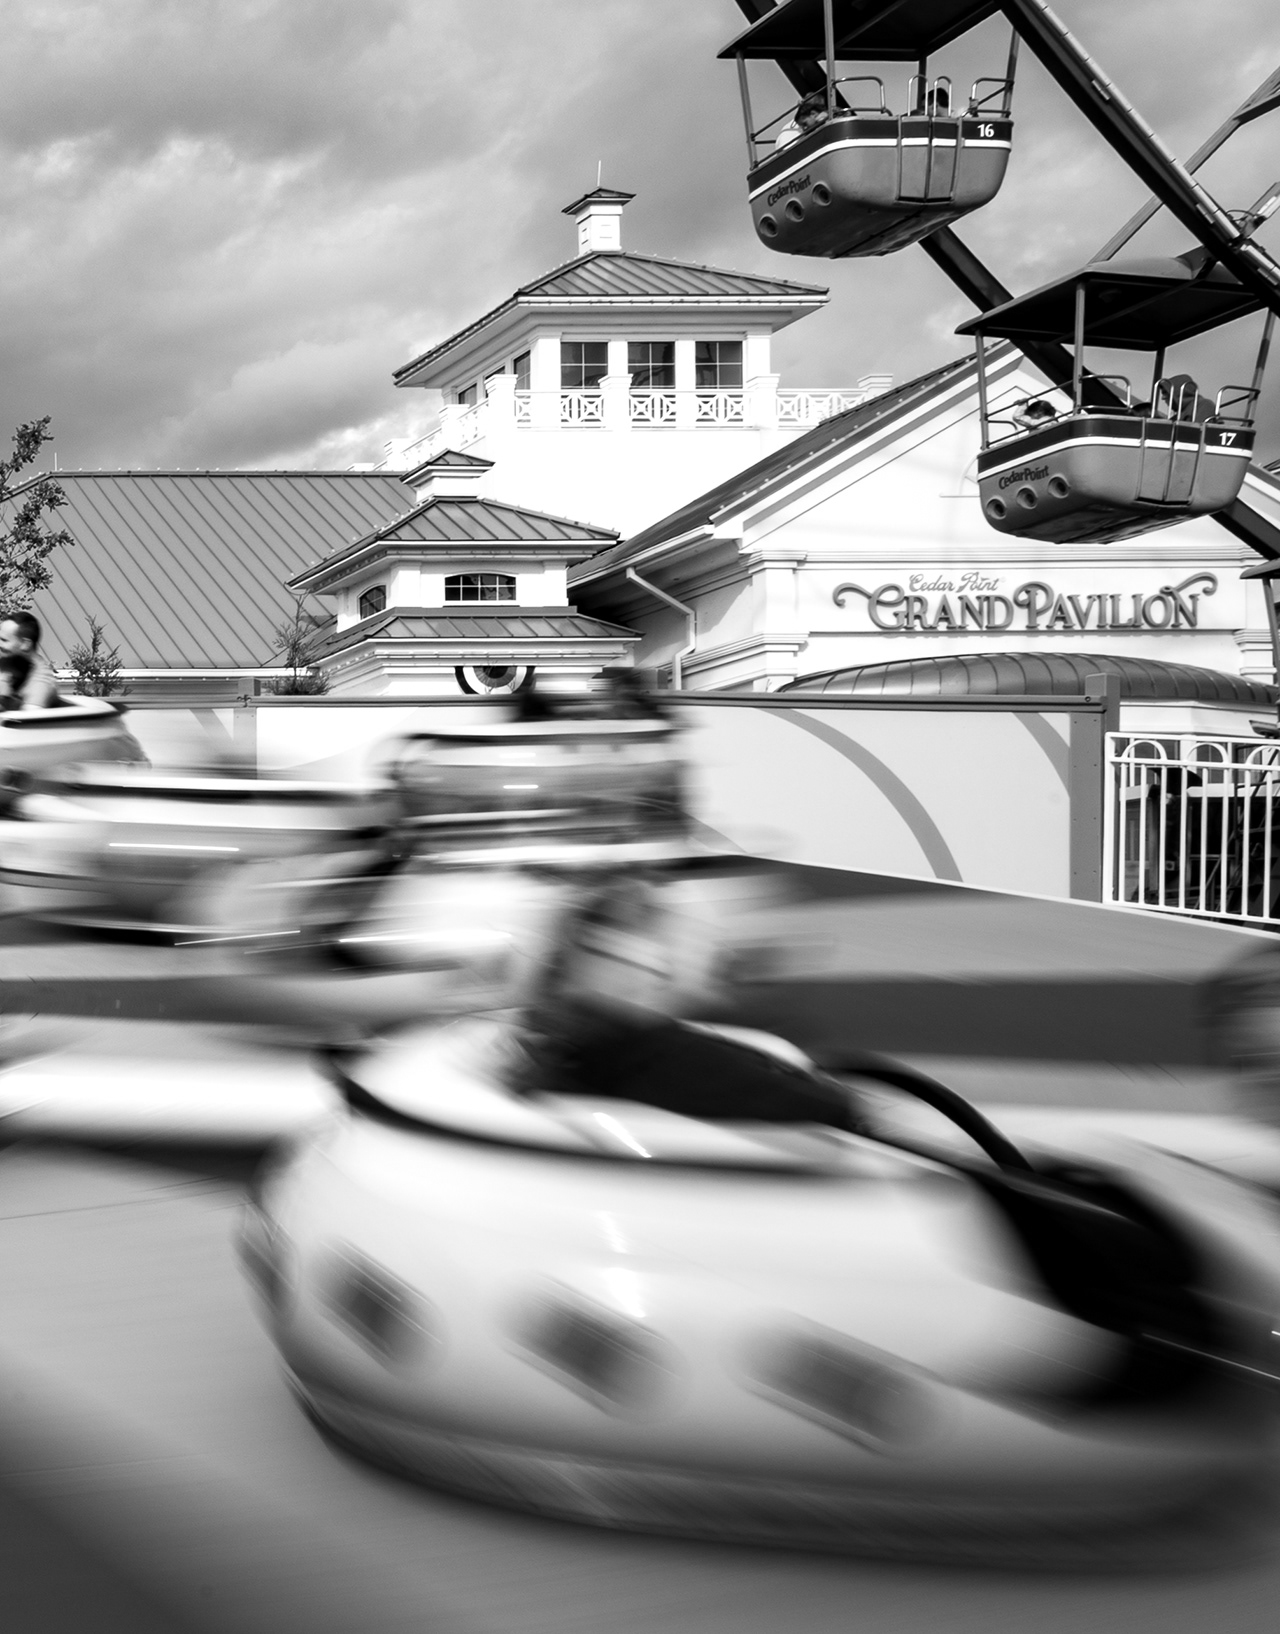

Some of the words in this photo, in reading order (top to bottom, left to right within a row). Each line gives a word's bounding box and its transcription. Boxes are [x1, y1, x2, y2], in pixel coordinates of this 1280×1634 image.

[977, 123, 995, 138] 16
[1219, 431, 1237, 446] 17
[909, 573, 955, 593] Cedar
[955, 571, 999, 593] Point
[833, 583, 1014, 631] GRAND
[1013, 572, 1218, 630] PAVILION
